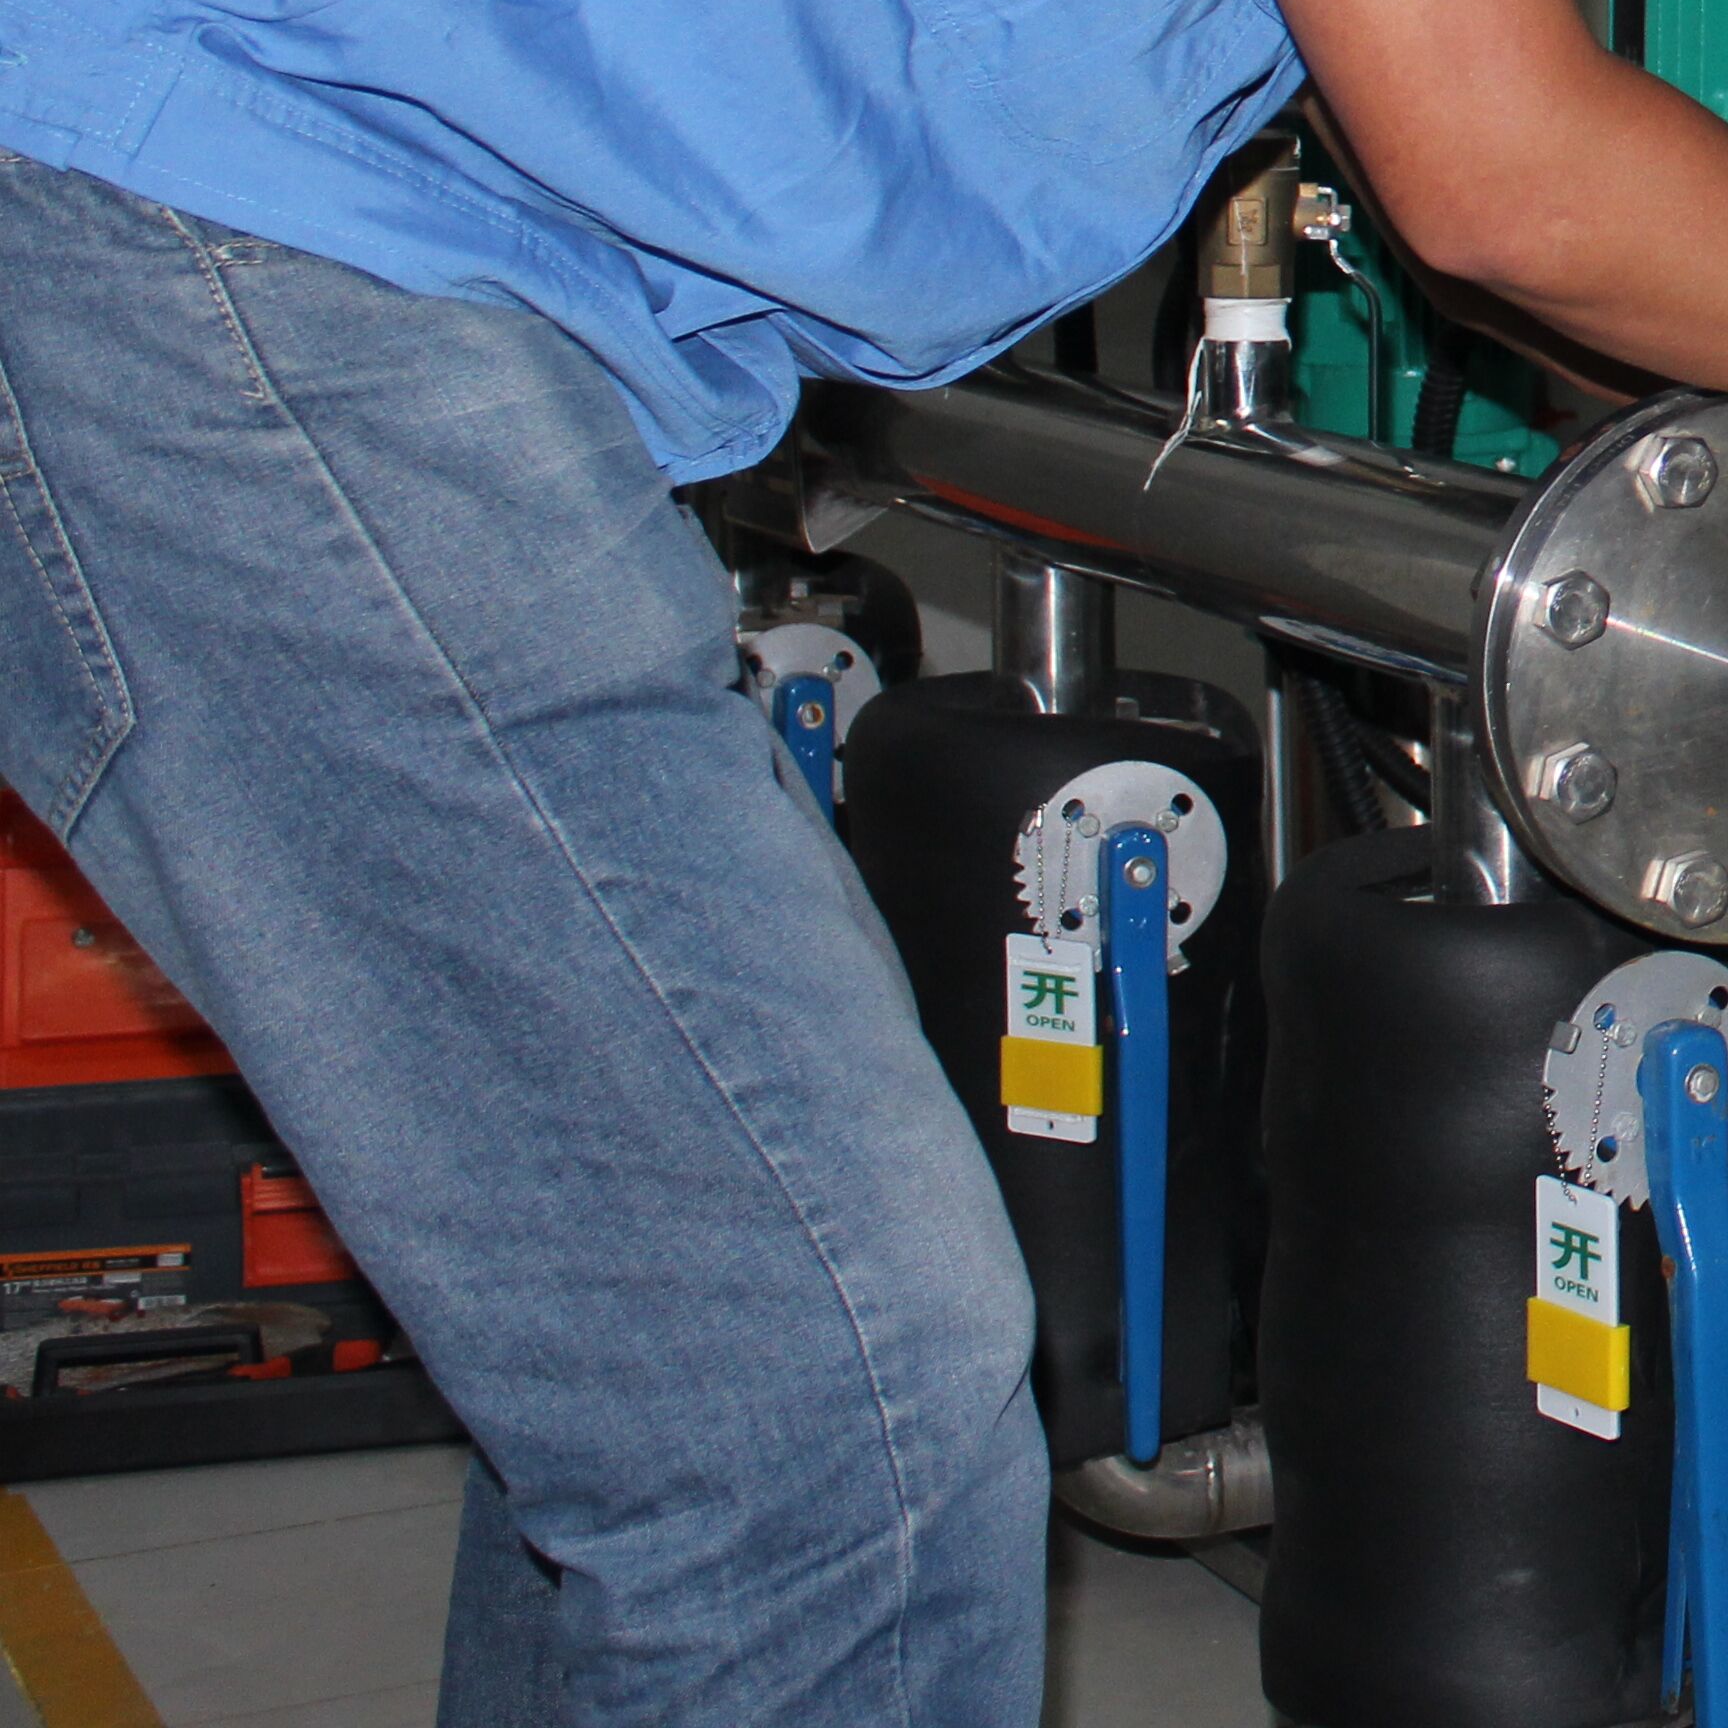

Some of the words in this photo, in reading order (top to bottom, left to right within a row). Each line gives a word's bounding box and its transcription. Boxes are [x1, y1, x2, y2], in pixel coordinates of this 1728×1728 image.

[1021, 969, 1079, 1015] 开
[1025, 1014, 1076, 1033] OPEN
[1550, 1221, 1602, 1281] 开
[1554, 1275, 1599, 1303] OPEN
